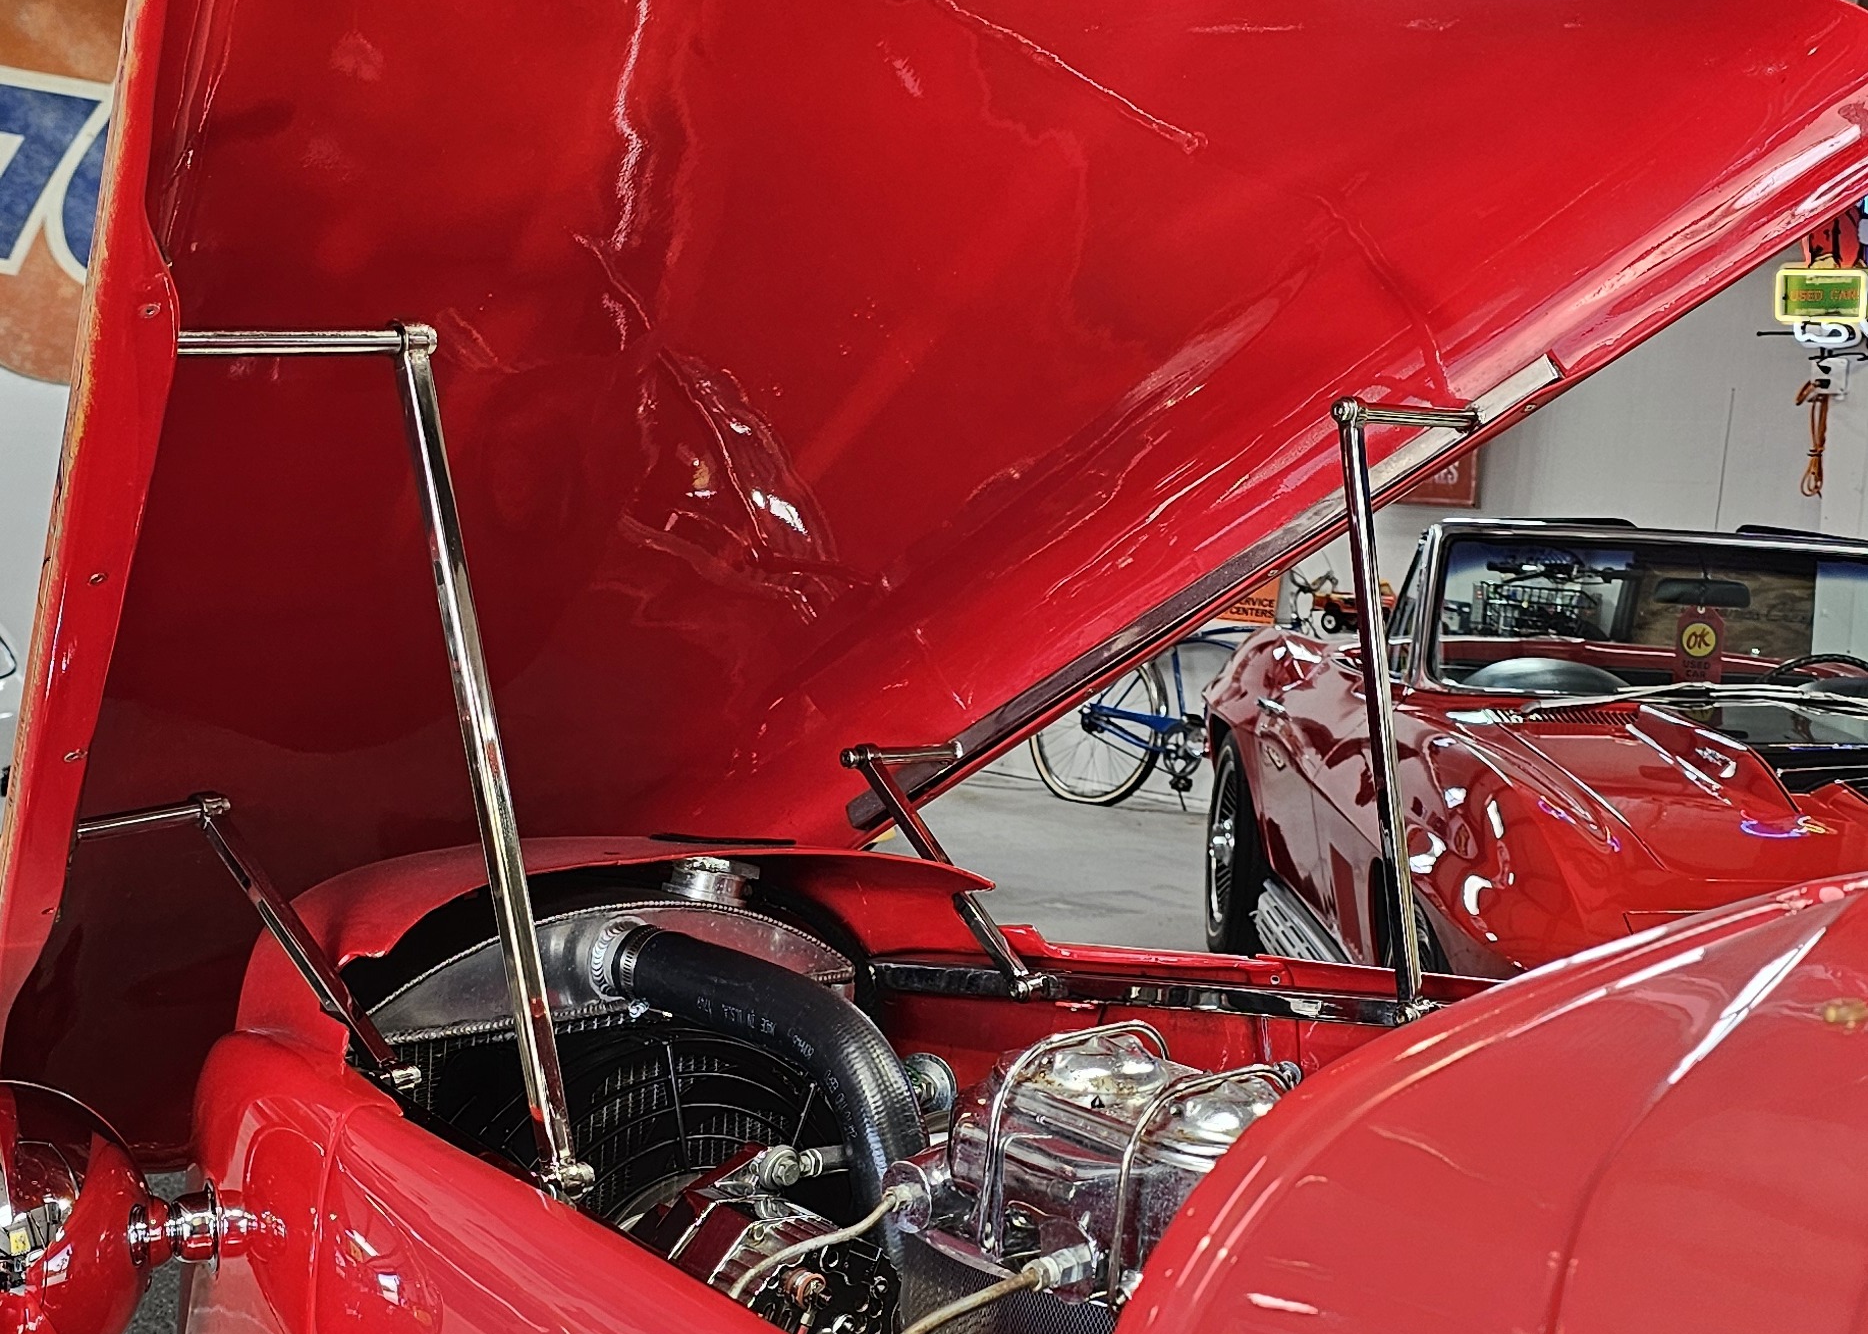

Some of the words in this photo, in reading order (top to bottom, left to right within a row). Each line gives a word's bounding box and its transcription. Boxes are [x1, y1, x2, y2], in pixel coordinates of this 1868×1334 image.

[1790, 290, 1823, 301] USED
[1239, 597, 1275, 608] RVICE
[1230, 606, 1275, 618] CENTERS
[1686, 628, 1710, 650] OK
[1682, 659, 1711, 670] USED
[1686, 669, 1706, 678] CAR
